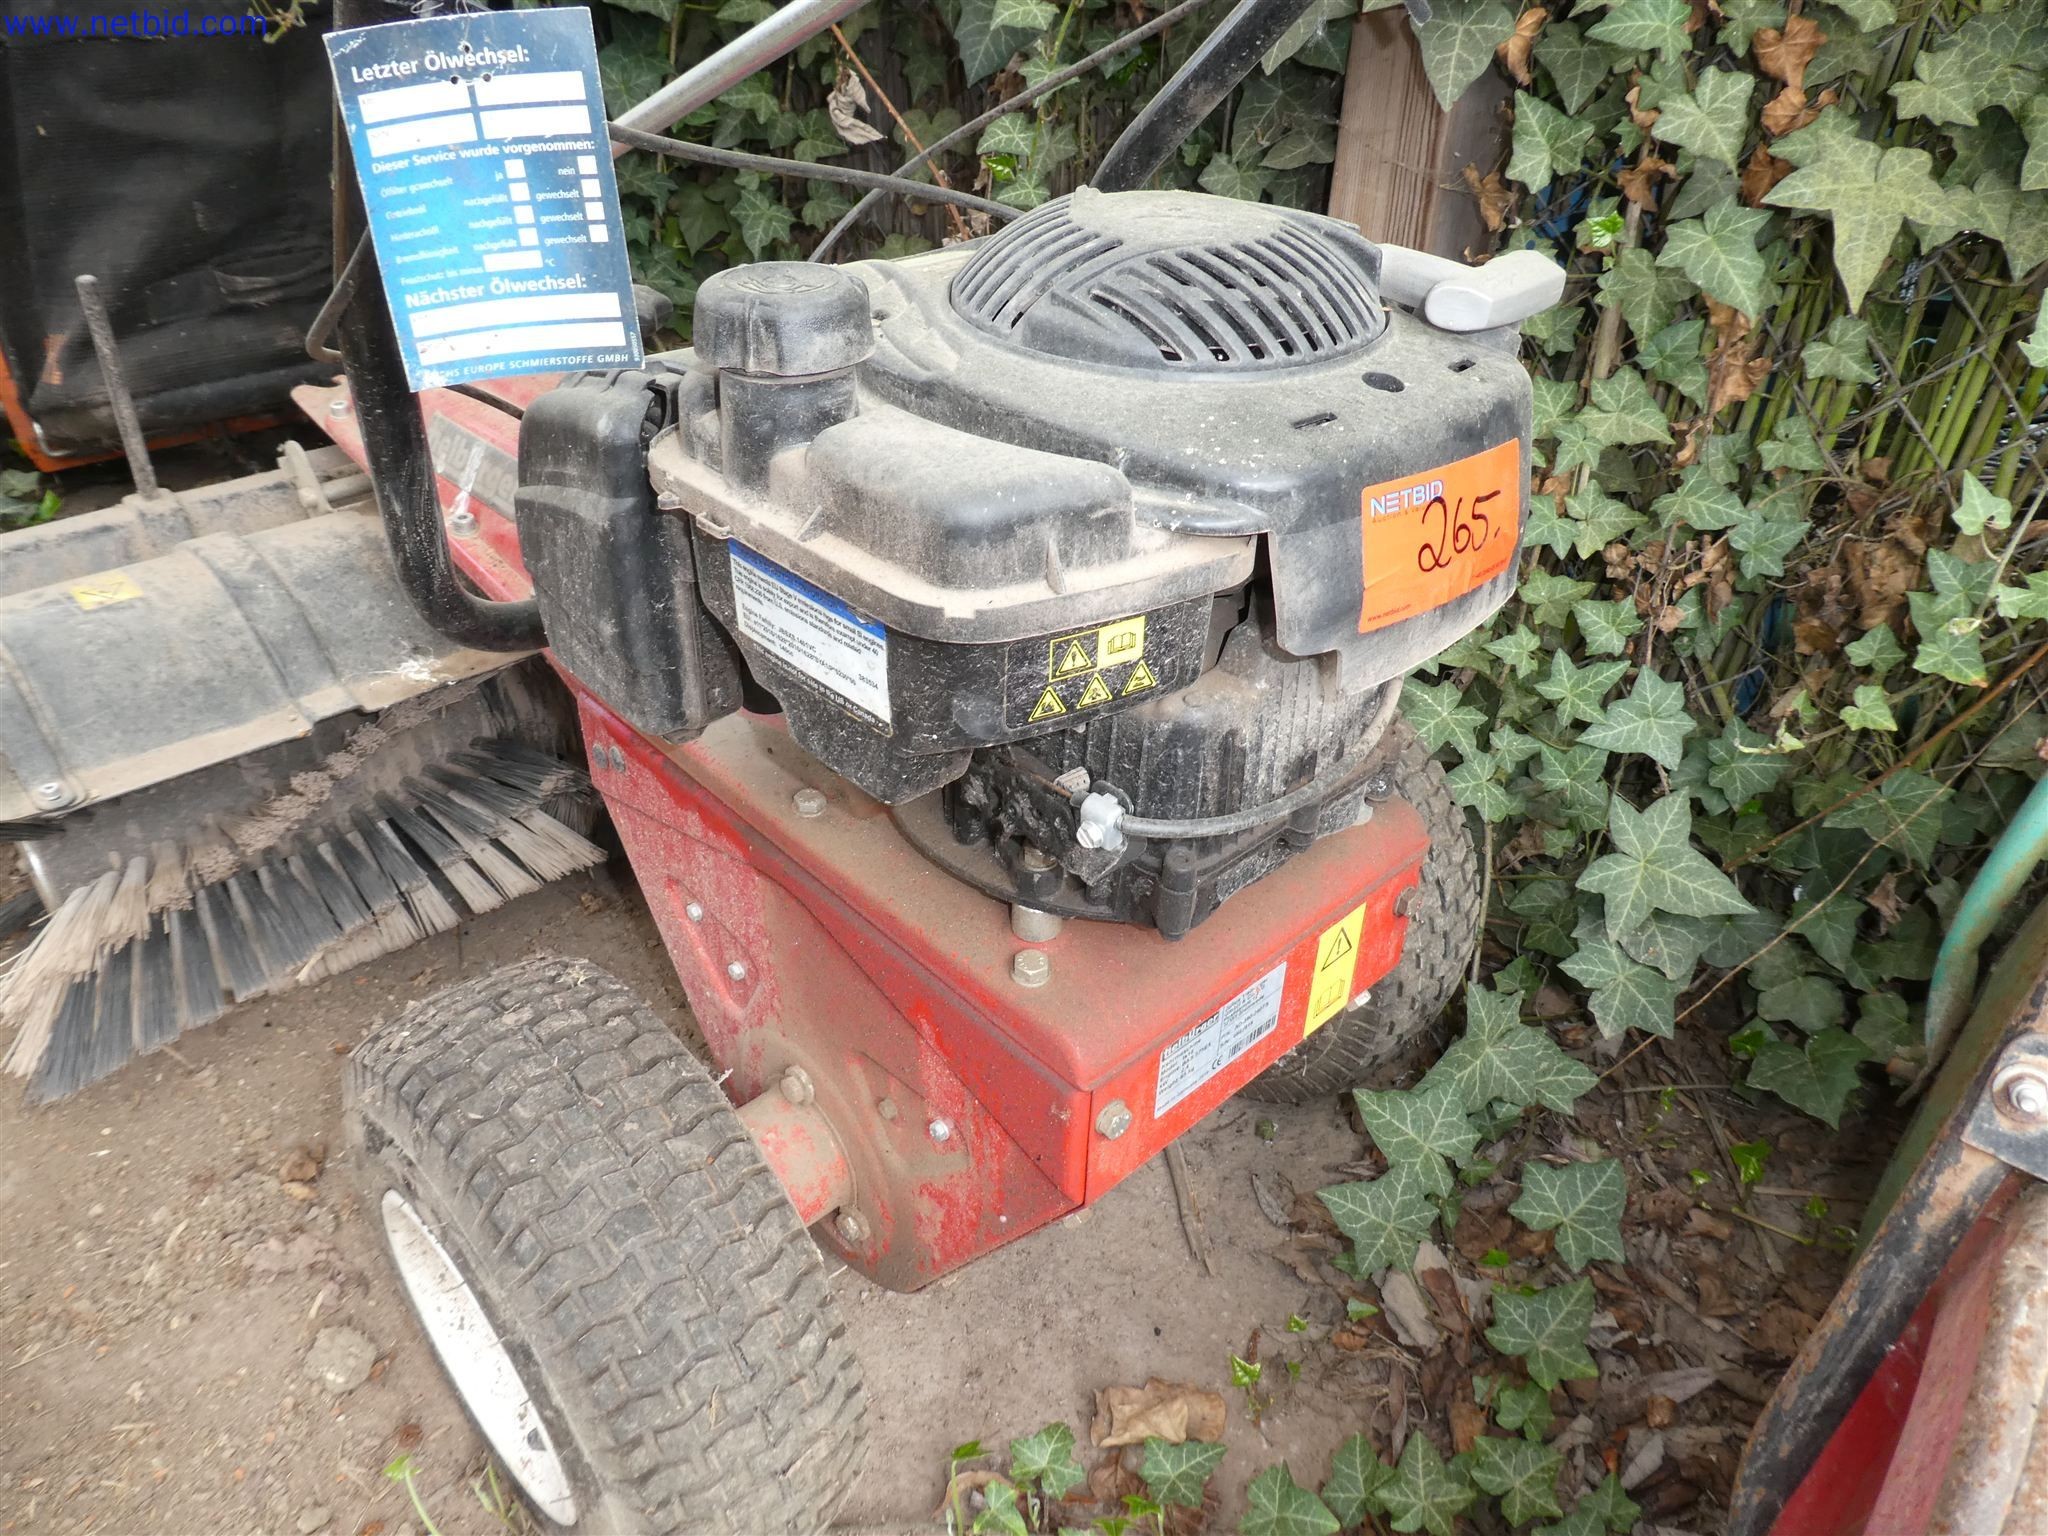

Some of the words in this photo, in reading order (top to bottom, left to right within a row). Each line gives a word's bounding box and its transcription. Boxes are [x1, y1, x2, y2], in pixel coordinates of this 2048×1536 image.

[352, 59, 418, 83] Letzter
[424, 45, 530, 72] Ölwechsel:
[372, 158, 410, 174] Dieser
[412, 150, 456, 166] Service
[459, 145, 500, 158] wurde
[502, 141, 595, 156] vorgenommen:
[495, 171, 504, 182] ja
[558, 166, 576, 176] nein
[536, 189, 580, 202] gewechselt
[540, 212, 584, 224] gewechselt
[544, 234, 588, 247] gewechselt
[404, 284, 484, 308] Nächster
[490, 274, 588, 294] Ölwechsel:
[464, 364, 506, 376] EUROPE
[509, 355, 594, 368] SCHMIERSTOFFE
[597, 354, 628, 362] GMBH
[1371, 480, 1443, 518] NETBID
